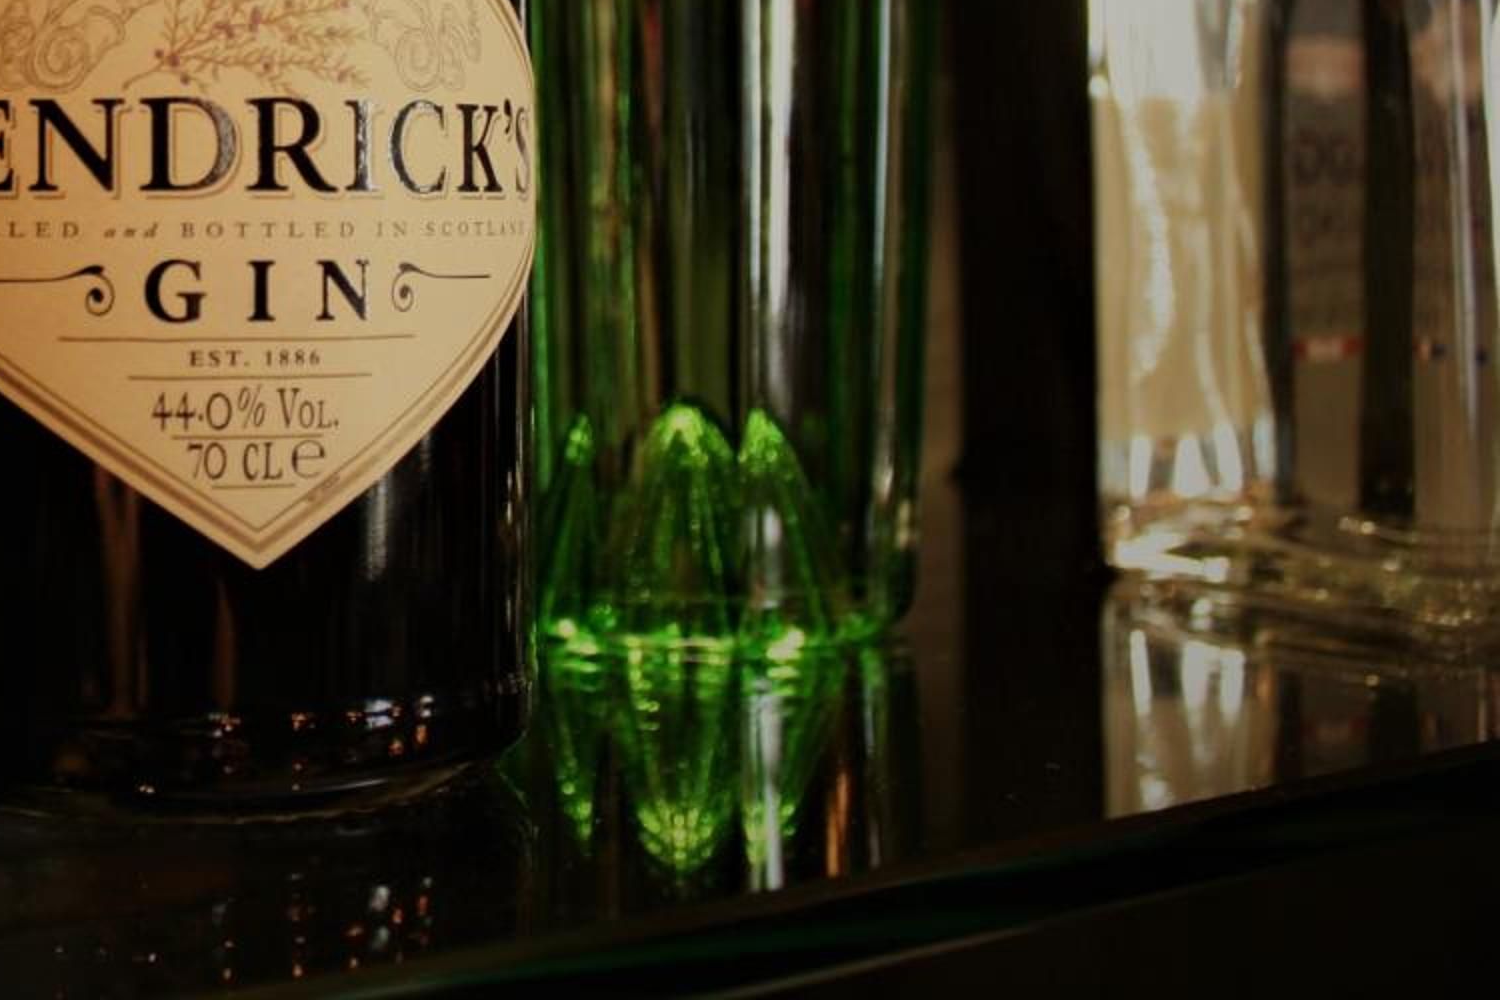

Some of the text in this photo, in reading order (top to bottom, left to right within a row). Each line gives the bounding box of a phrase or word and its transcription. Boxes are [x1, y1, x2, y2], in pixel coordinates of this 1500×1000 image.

[104, 223, 159, 239] and
[181, 220, 356, 239] BOTTLED
[376, 221, 407, 237] IN
[145, 258, 370, 322] GIN
[189, 349, 321, 367] EST. 1886
[152, 384, 266, 431] 44.0%
[188, 441, 228, 480] 70
